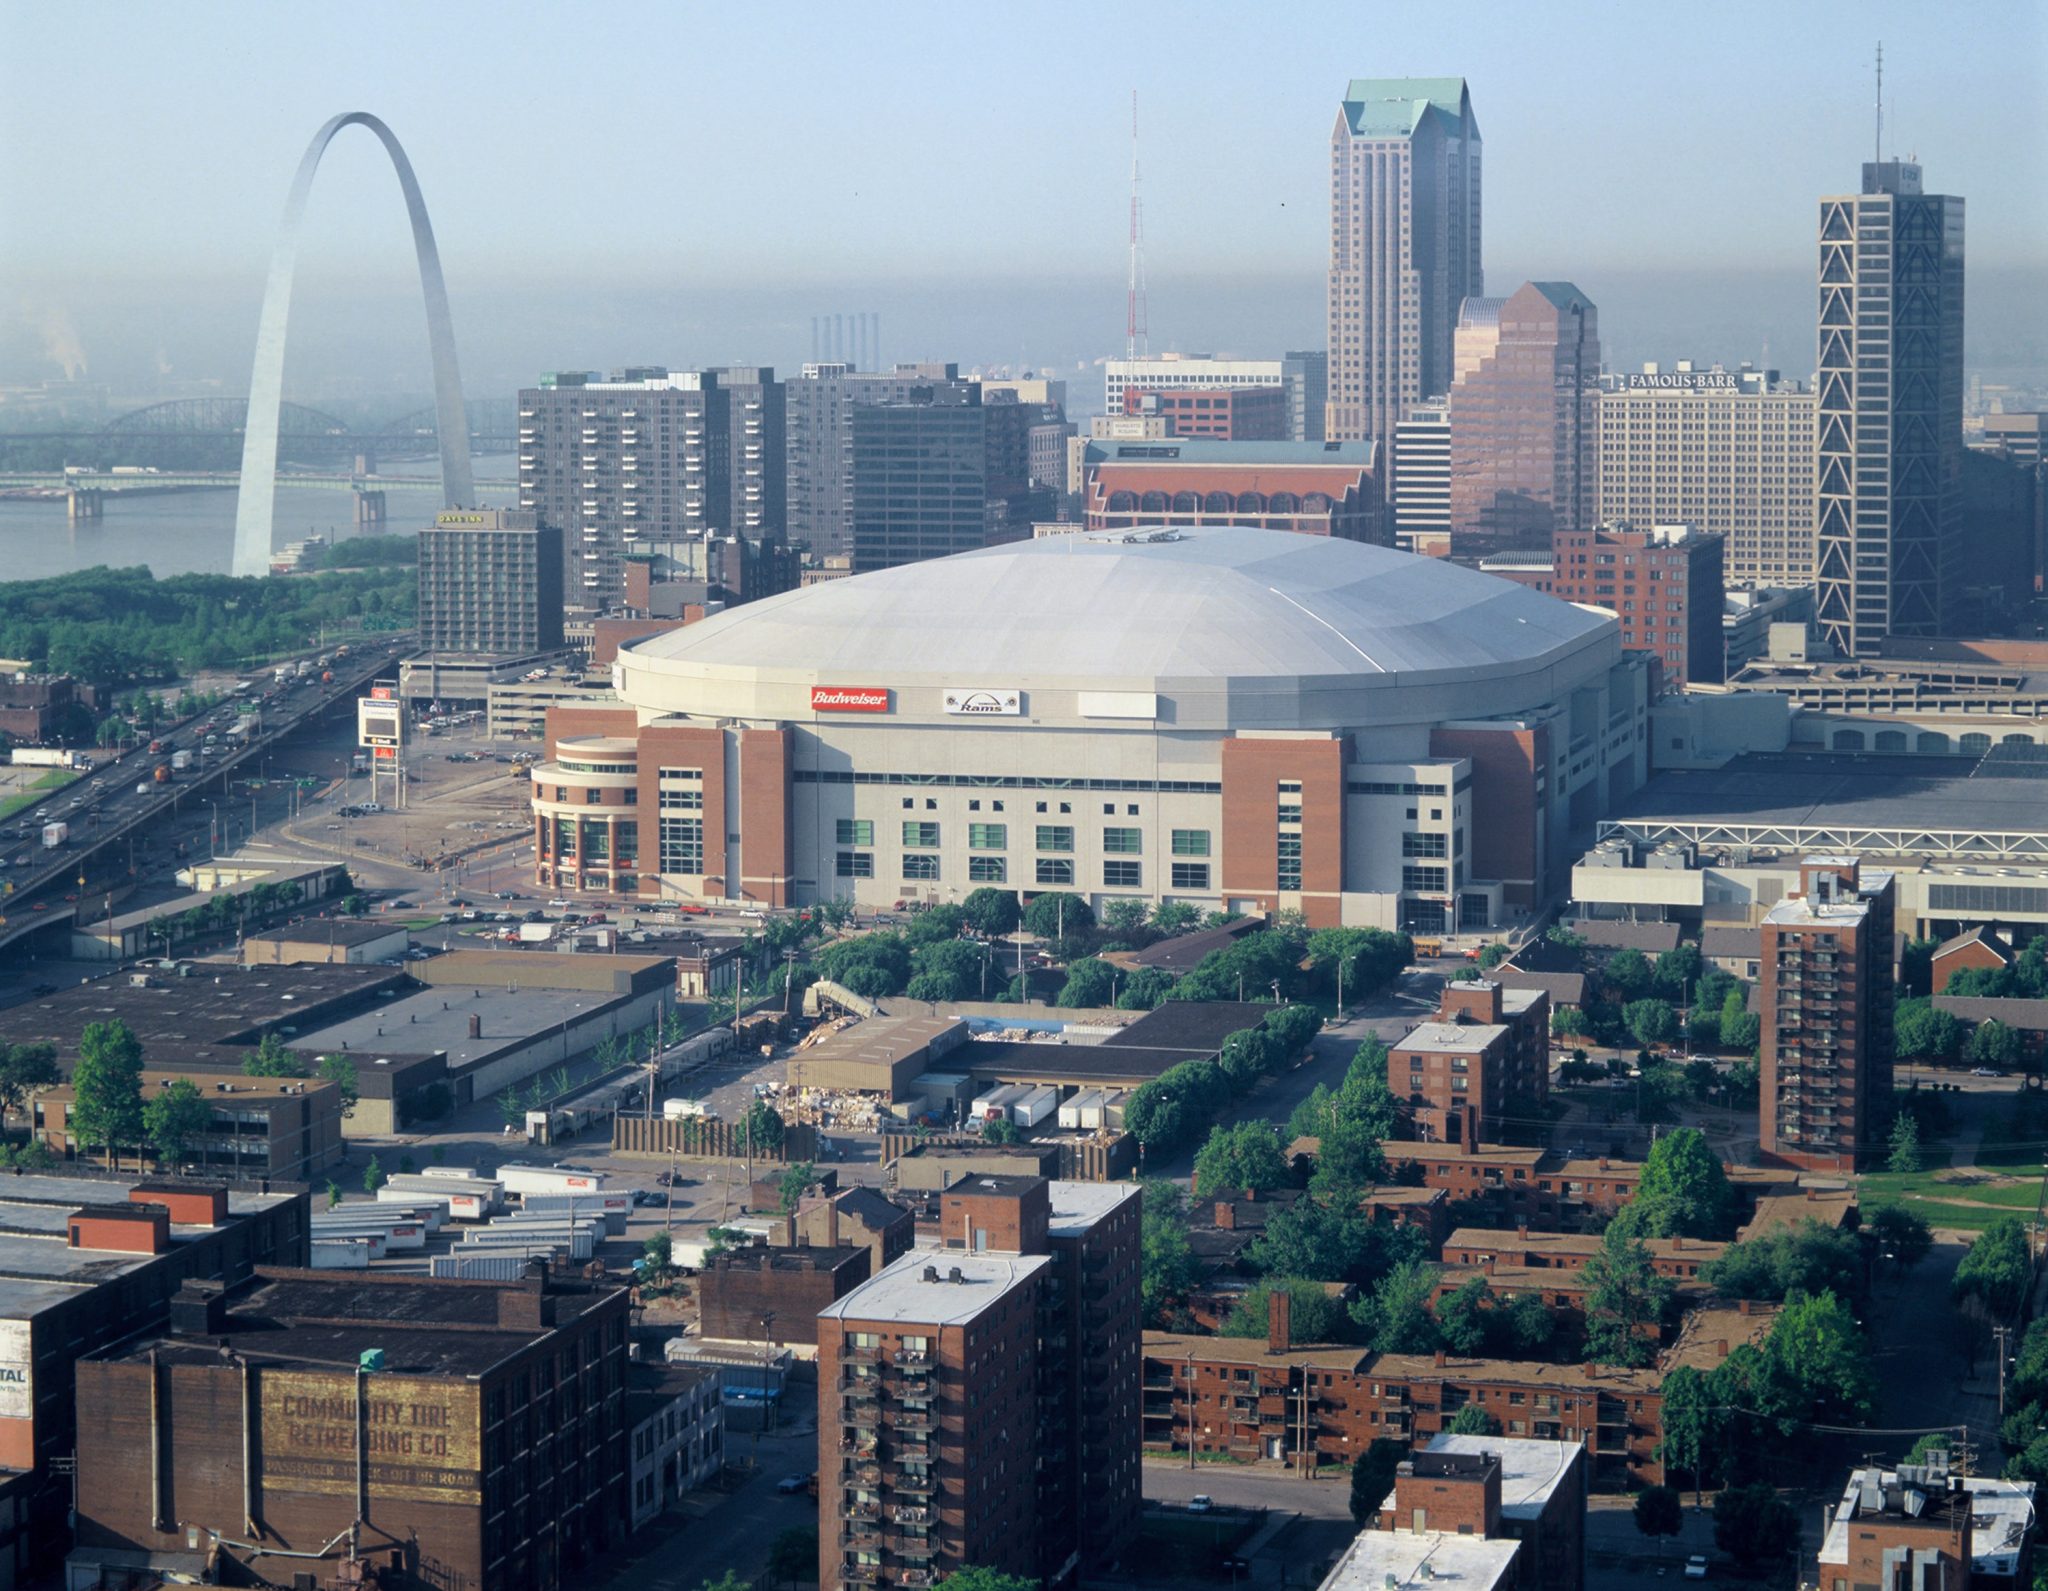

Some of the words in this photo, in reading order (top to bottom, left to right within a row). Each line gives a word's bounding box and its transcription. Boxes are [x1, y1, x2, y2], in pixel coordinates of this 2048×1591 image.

[813, 691, 887, 705] Budweiser
[961, 704, 1002, 712] Rams
[283, 1395, 403, 1425] COMMUITY
[409, 1404, 451, 1428] TIRE
[266, 1461, 334, 1476] PASSENGER
[439, 1473, 475, 1486] ROAD
